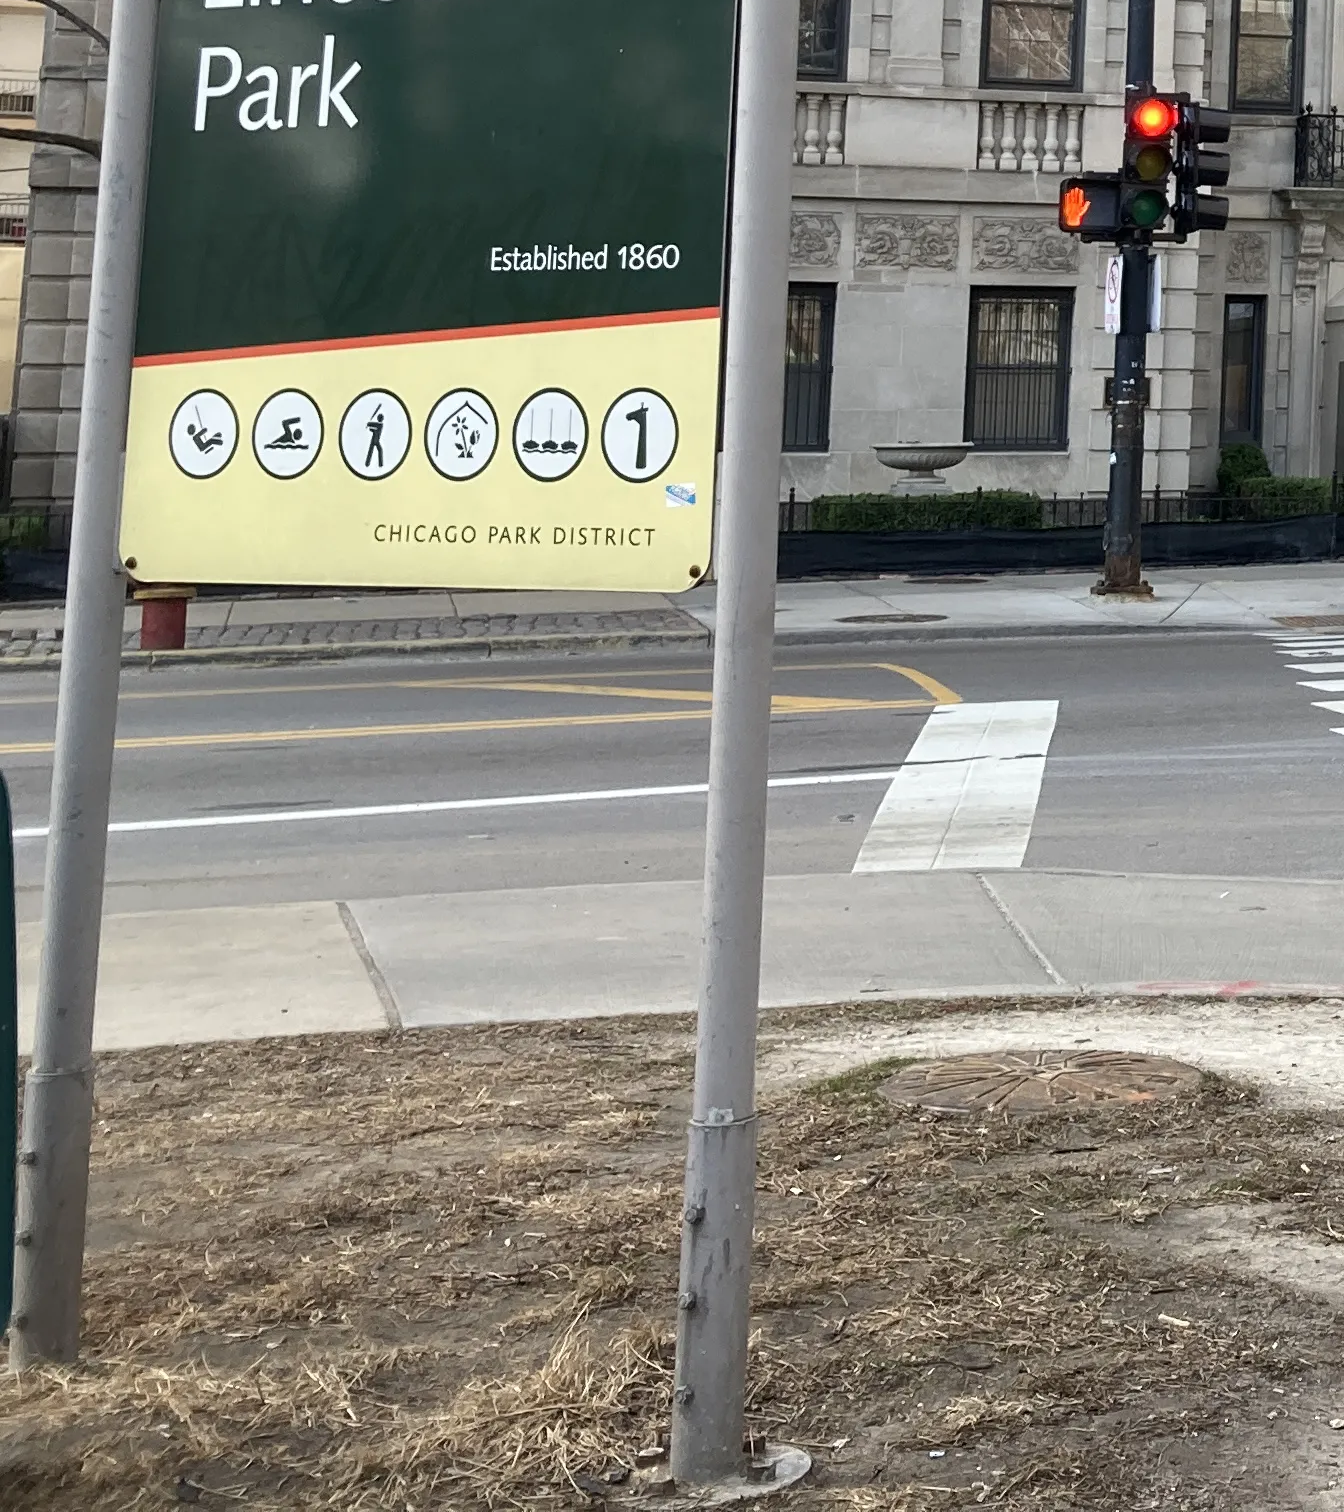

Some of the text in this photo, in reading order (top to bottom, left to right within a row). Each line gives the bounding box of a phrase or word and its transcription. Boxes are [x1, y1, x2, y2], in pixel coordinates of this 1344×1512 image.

[194, 34, 362, 132] Park
[490, 243, 681, 272] Established 1860
[374, 524, 656, 547] CHICAGO PARK DISTRICT
